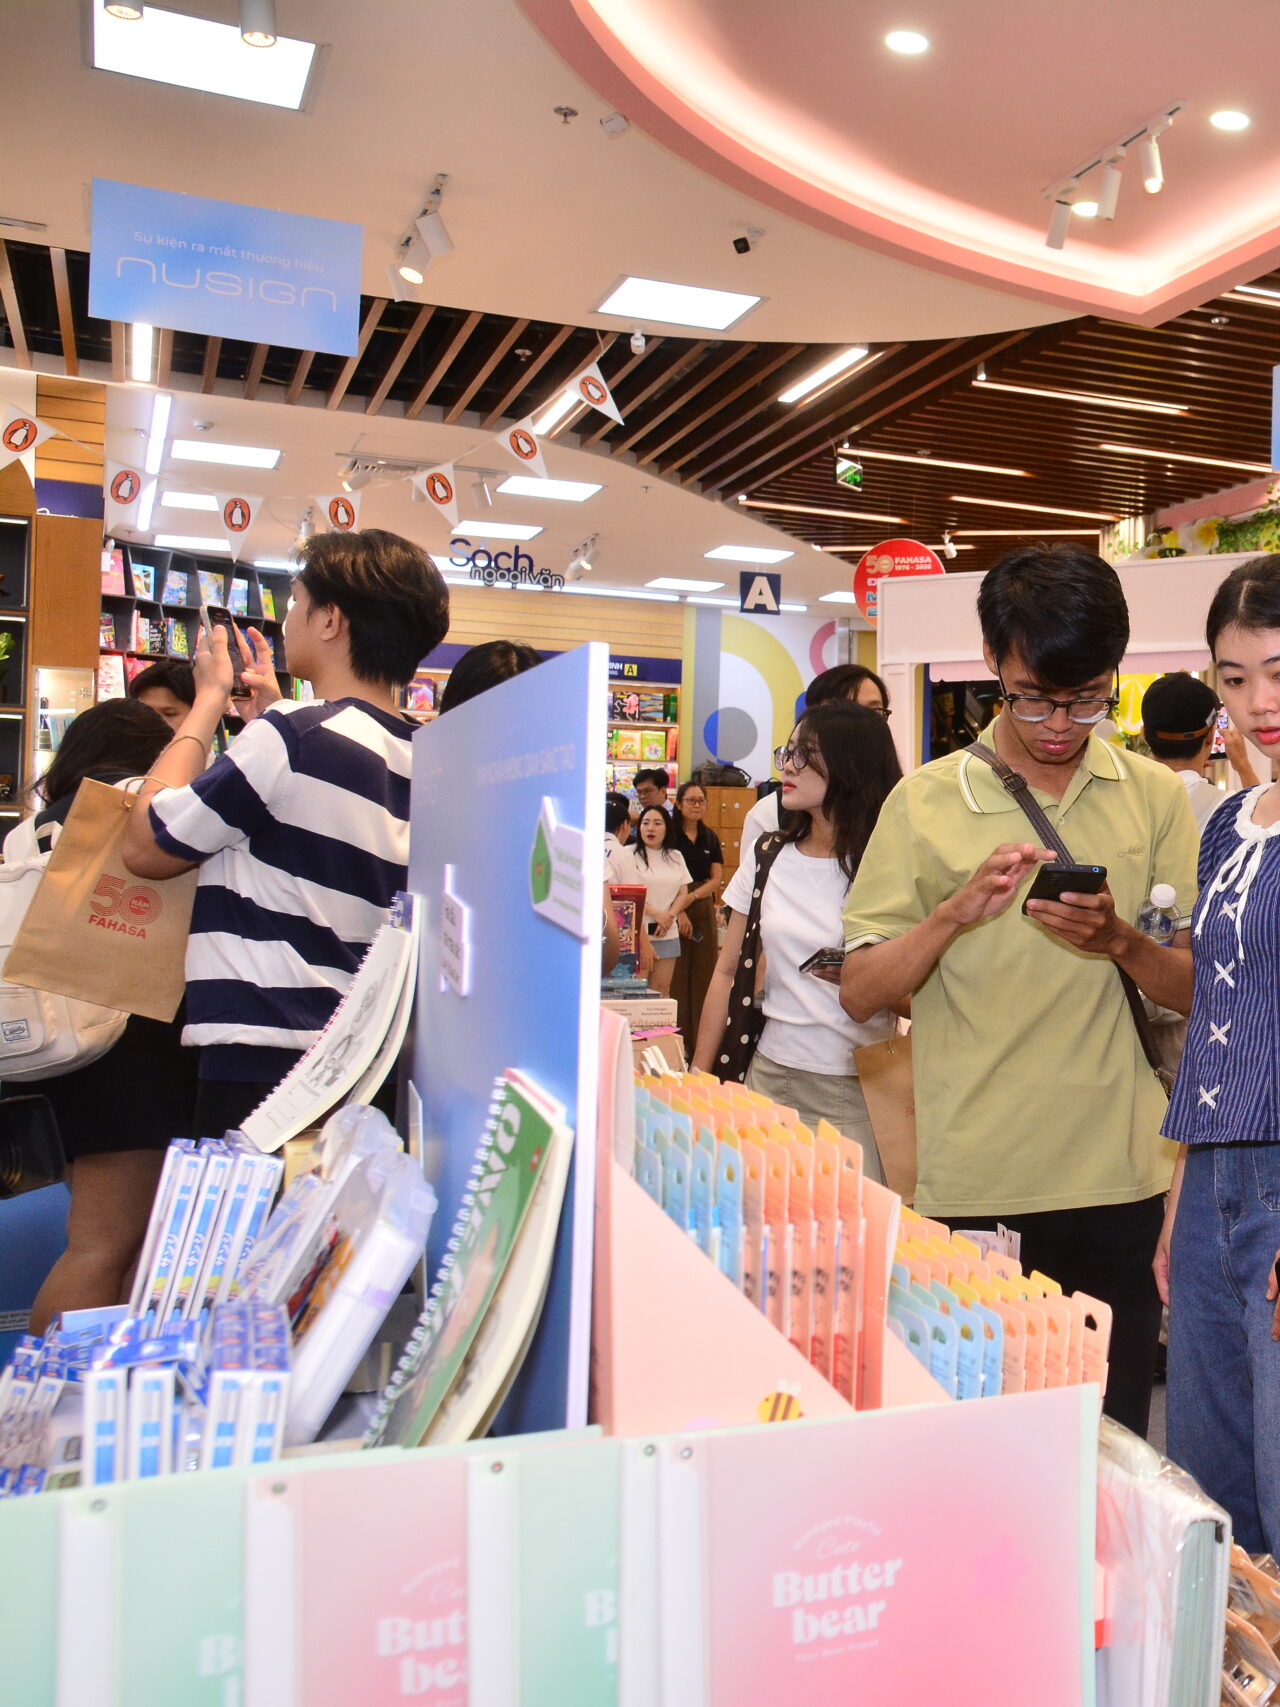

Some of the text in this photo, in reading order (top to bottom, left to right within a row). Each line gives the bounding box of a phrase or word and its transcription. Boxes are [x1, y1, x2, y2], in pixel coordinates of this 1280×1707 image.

[191, 241, 205, 253] ra
[449, 537, 534, 572] Sách
[743, 575, 779, 611] A
[88, 914, 147, 939] FAHASA
[771, 1557, 905, 1610] Butter
[375, 1608, 467, 1658] But
[791, 1599, 888, 1645] bear
[400, 1656, 468, 1697] be
